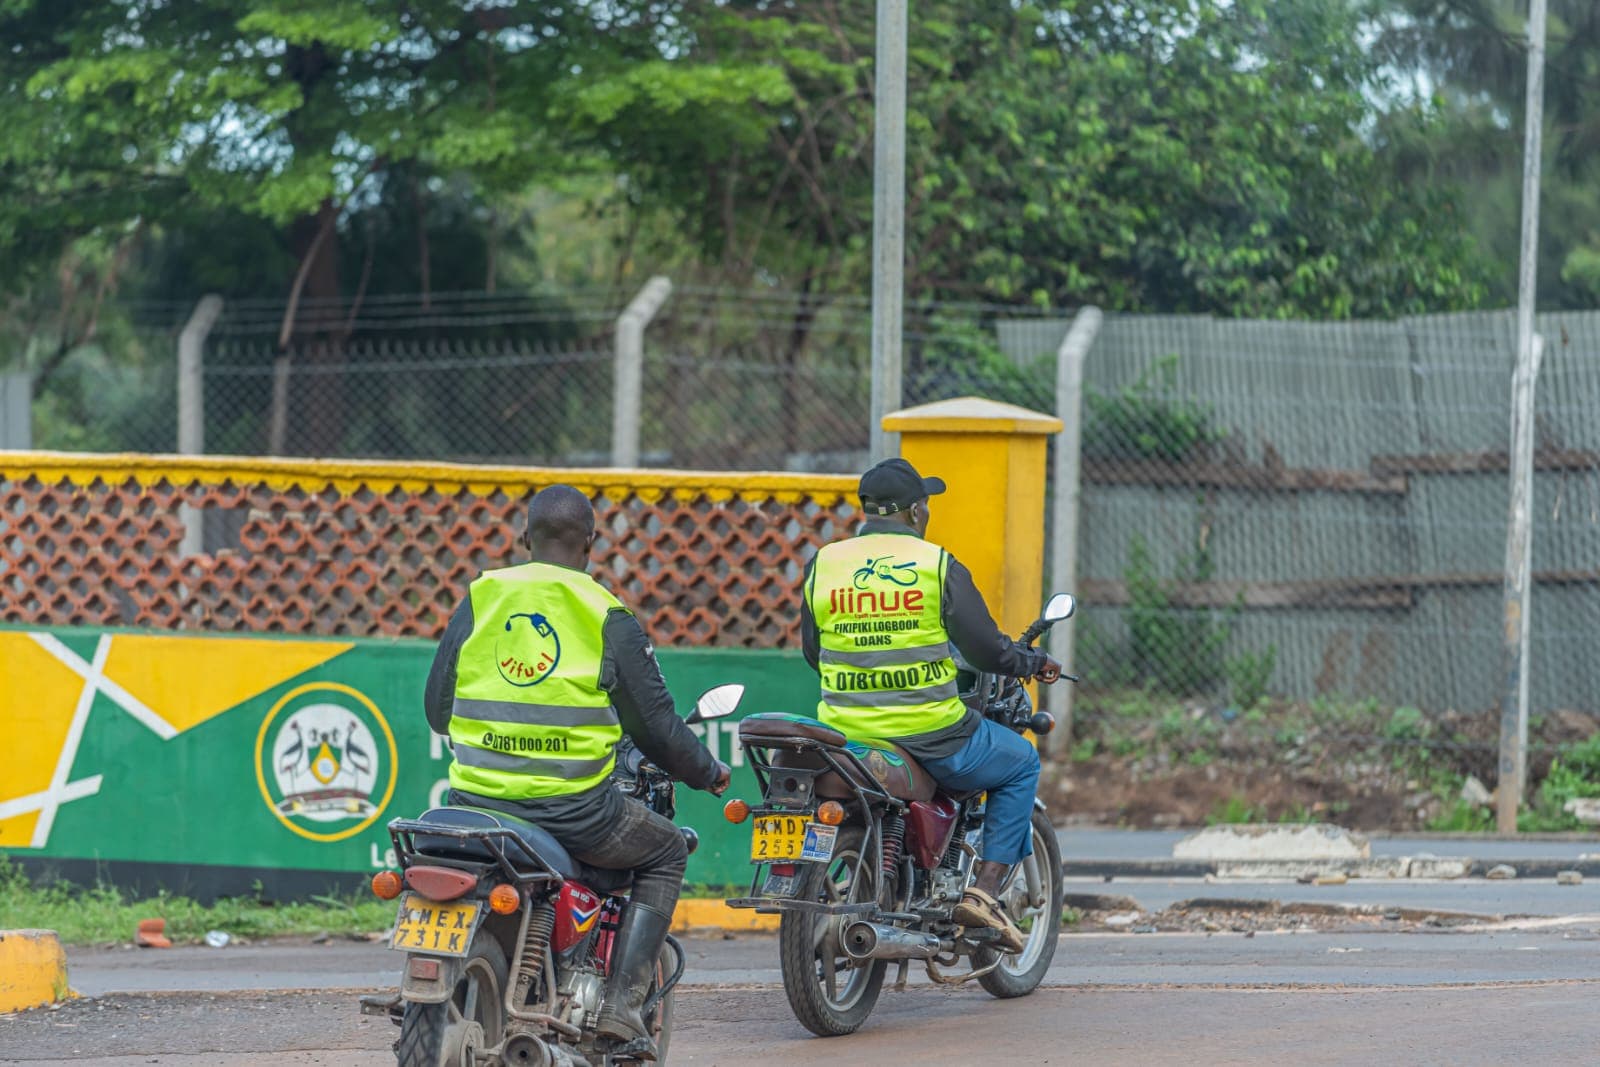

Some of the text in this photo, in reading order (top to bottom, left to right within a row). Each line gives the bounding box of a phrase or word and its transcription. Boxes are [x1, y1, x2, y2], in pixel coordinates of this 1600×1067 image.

[829, 588, 924, 615] Jiinue
[834, 619, 919, 634] PIKIPIKI LOGBOOK
[854, 635, 892, 646] LOANS
[501, 652, 554, 678] Jifuel
[836, 660, 949, 691] 0781 000 201
[519, 736, 542, 752] 000
[545, 737, 568, 752] 201
[758, 839, 805, 856] 255
[400, 906, 466, 929] KMEX
[396, 929, 461, 951] 731K
